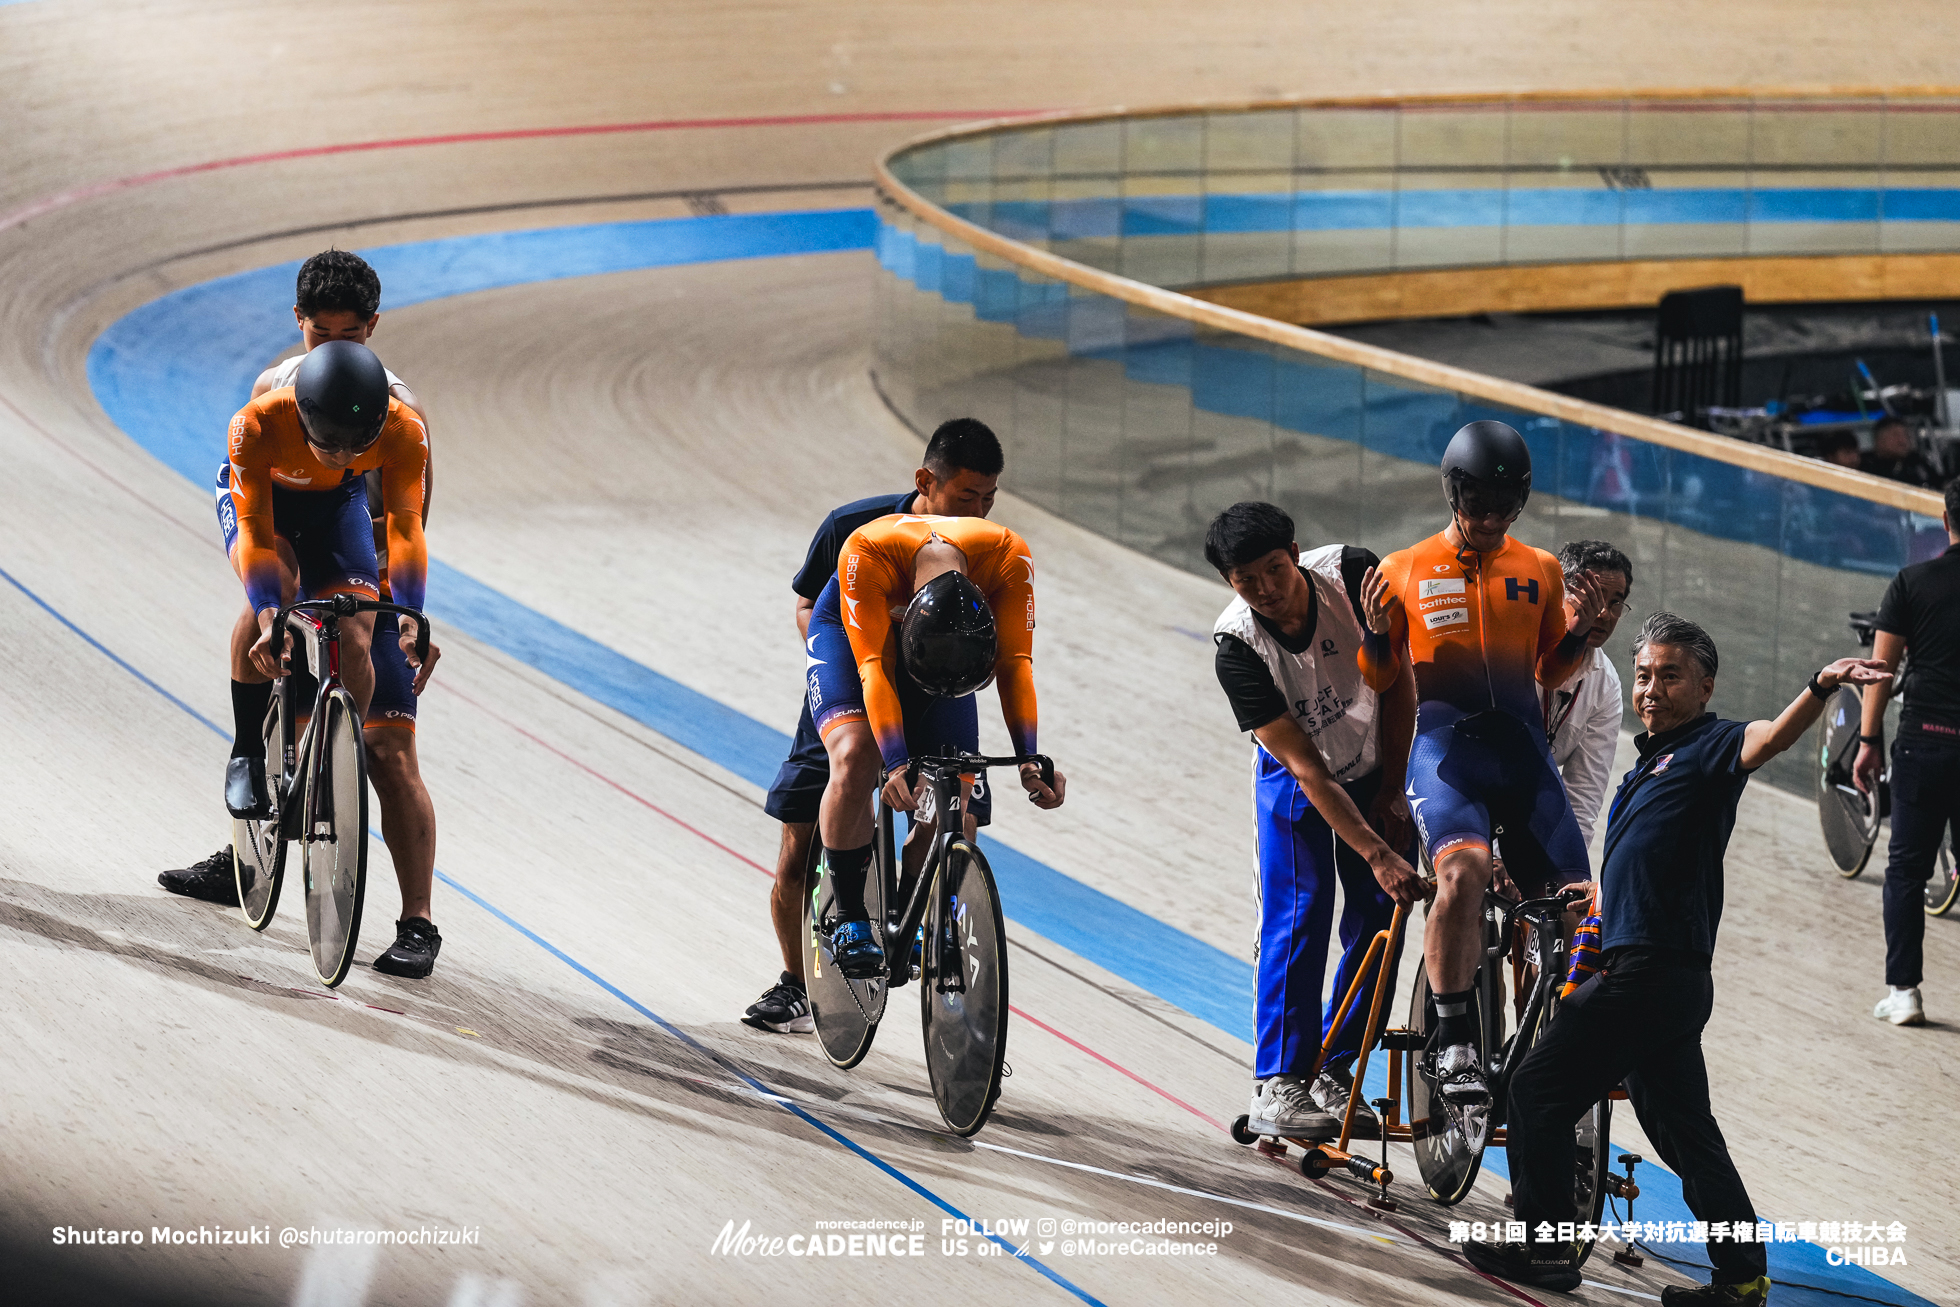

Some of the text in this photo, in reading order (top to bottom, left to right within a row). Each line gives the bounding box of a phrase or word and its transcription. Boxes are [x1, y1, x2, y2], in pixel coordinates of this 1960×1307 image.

[231, 415, 246, 456] HOSEI
[846, 554, 860, 592] HOSEI
[1504, 577, 1539, 605] H
[1026, 593, 1034, 632] HOSEI
[1418, 596, 1467, 611] bathtec
[808, 669, 823, 711] HOSEI
